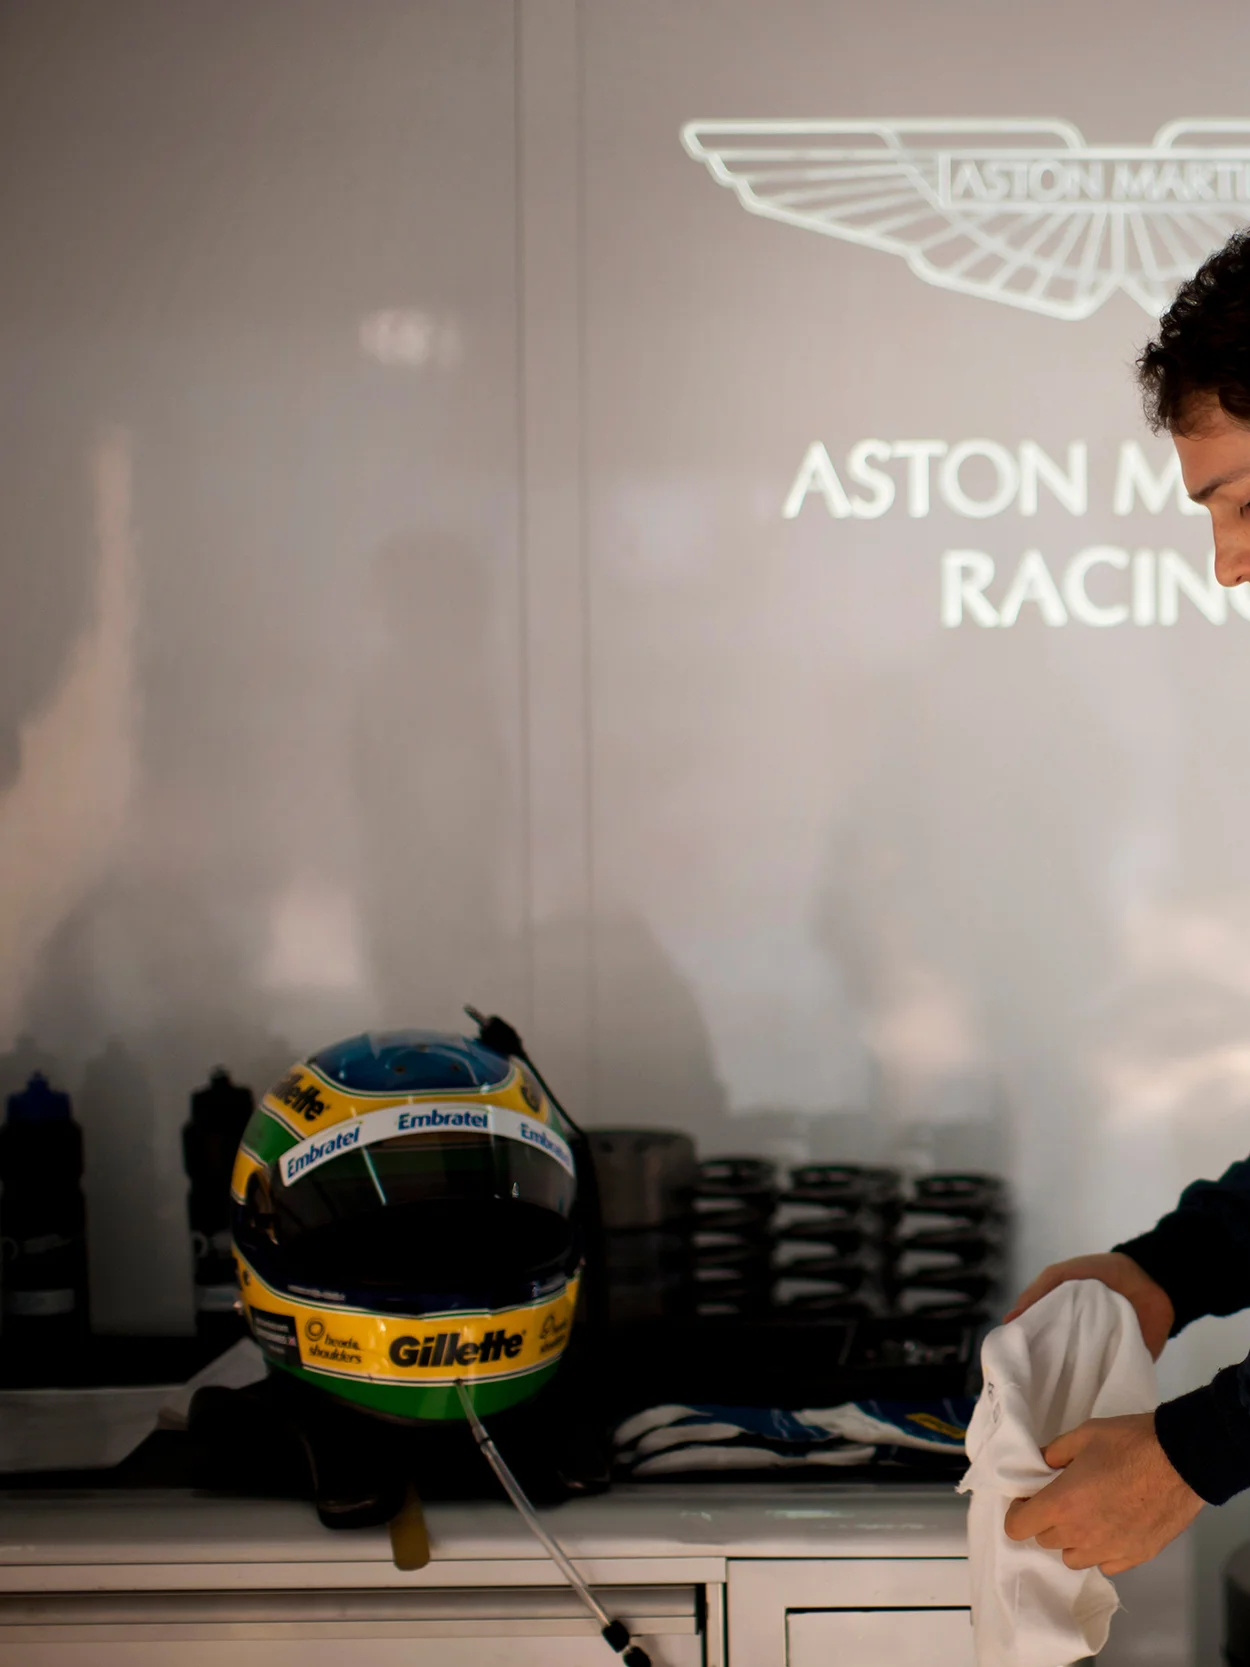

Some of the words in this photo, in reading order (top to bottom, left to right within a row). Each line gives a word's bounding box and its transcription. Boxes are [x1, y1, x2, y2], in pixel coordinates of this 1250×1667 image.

[954, 159, 1102, 200] ASTON
[782, 438, 1088, 519] ASTON
[287, 1127, 360, 1178] Embratel
[398, 1109, 489, 1130] Embratel
[388, 1329, 523, 1368] Gillette
